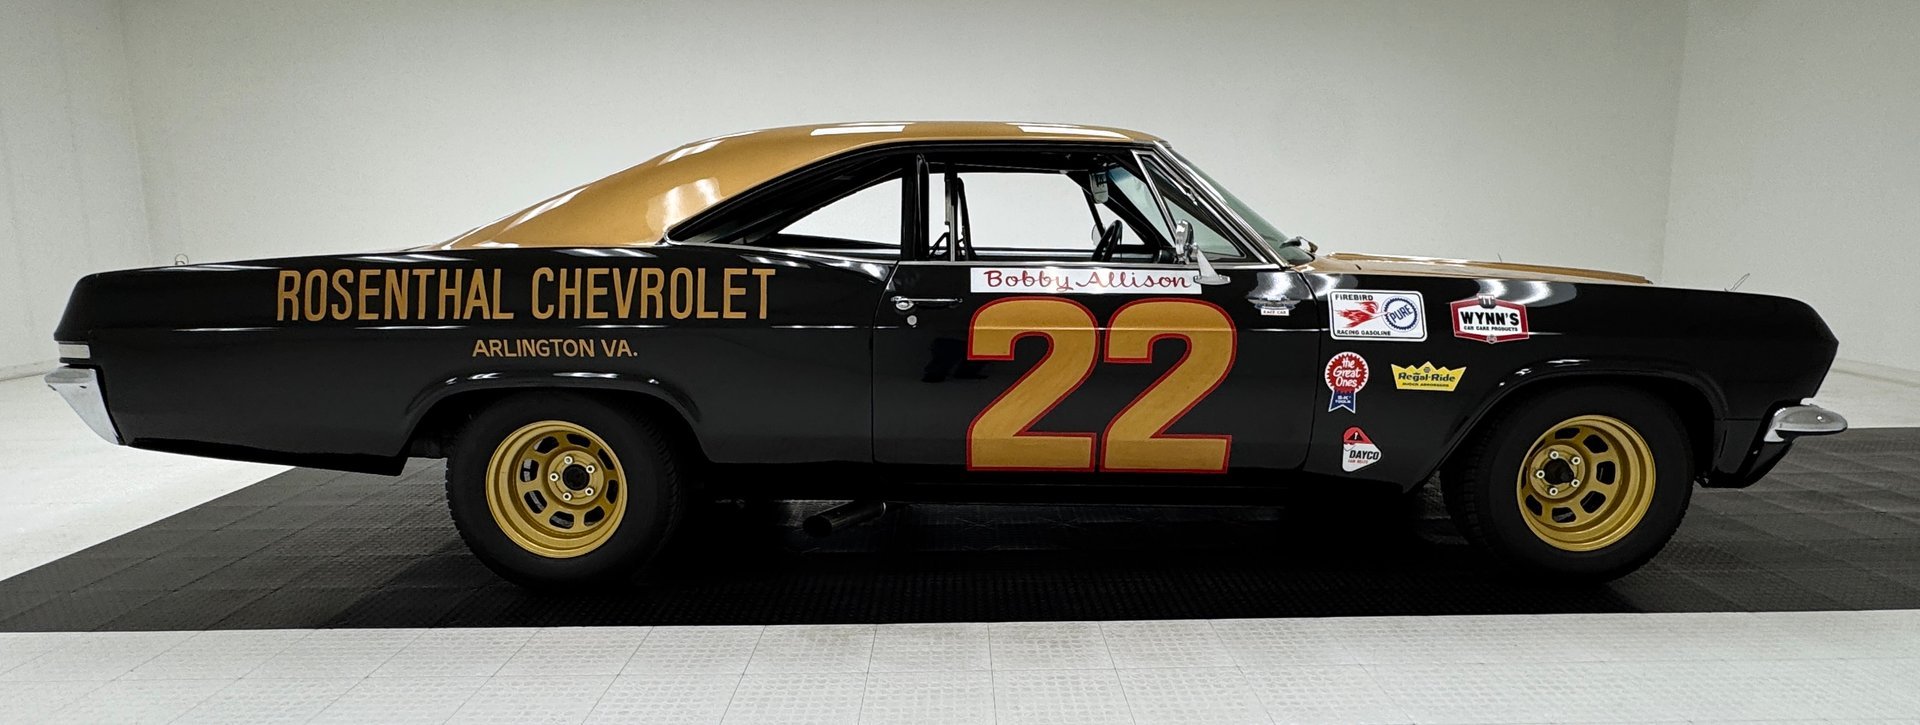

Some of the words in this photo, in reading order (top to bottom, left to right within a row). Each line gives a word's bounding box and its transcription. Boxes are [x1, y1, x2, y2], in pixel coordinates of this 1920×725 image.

[983, 270, 1074, 291] Bobby
[1075, 271, 1191, 289] Allison
[276, 268, 514, 321] ROSENTHAL
[531, 267, 776, 320] CHEVROLET
[1389, 304, 1414, 324] PURE
[1460, 311, 1520, 326] WYNN'S
[472, 338, 596, 358] ARLINGTON
[600, 339, 639, 358] VA.
[1342, 357, 1355, 368] the
[1333, 366, 1361, 378] Great
[966, 296, 1237, 474] 22
[1336, 377, 1357, 387] Ones
[1349, 450, 1379, 460] DAYCO
